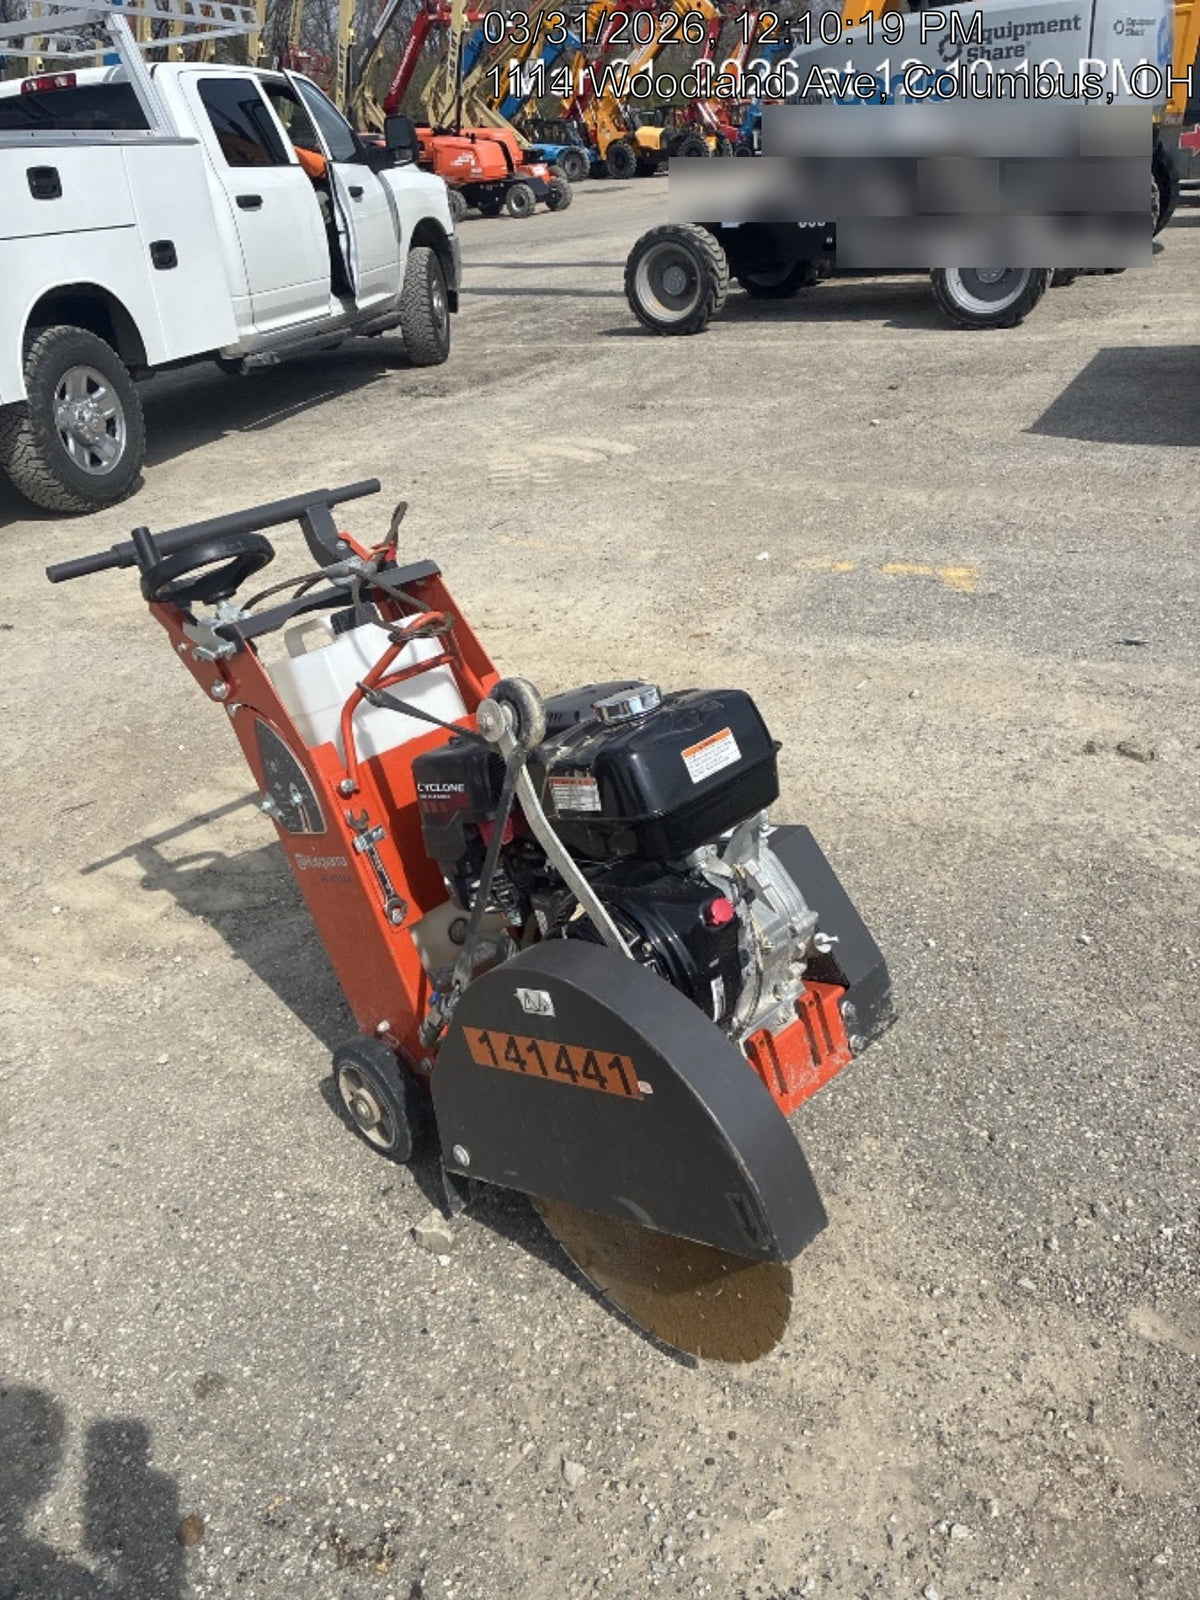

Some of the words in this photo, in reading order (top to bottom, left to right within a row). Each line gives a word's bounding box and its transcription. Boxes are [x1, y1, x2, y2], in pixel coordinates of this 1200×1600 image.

[966, 43, 1026, 63] Share
[417, 783, 465, 792] CYCLONE
[477, 1030, 633, 1096] 141441
